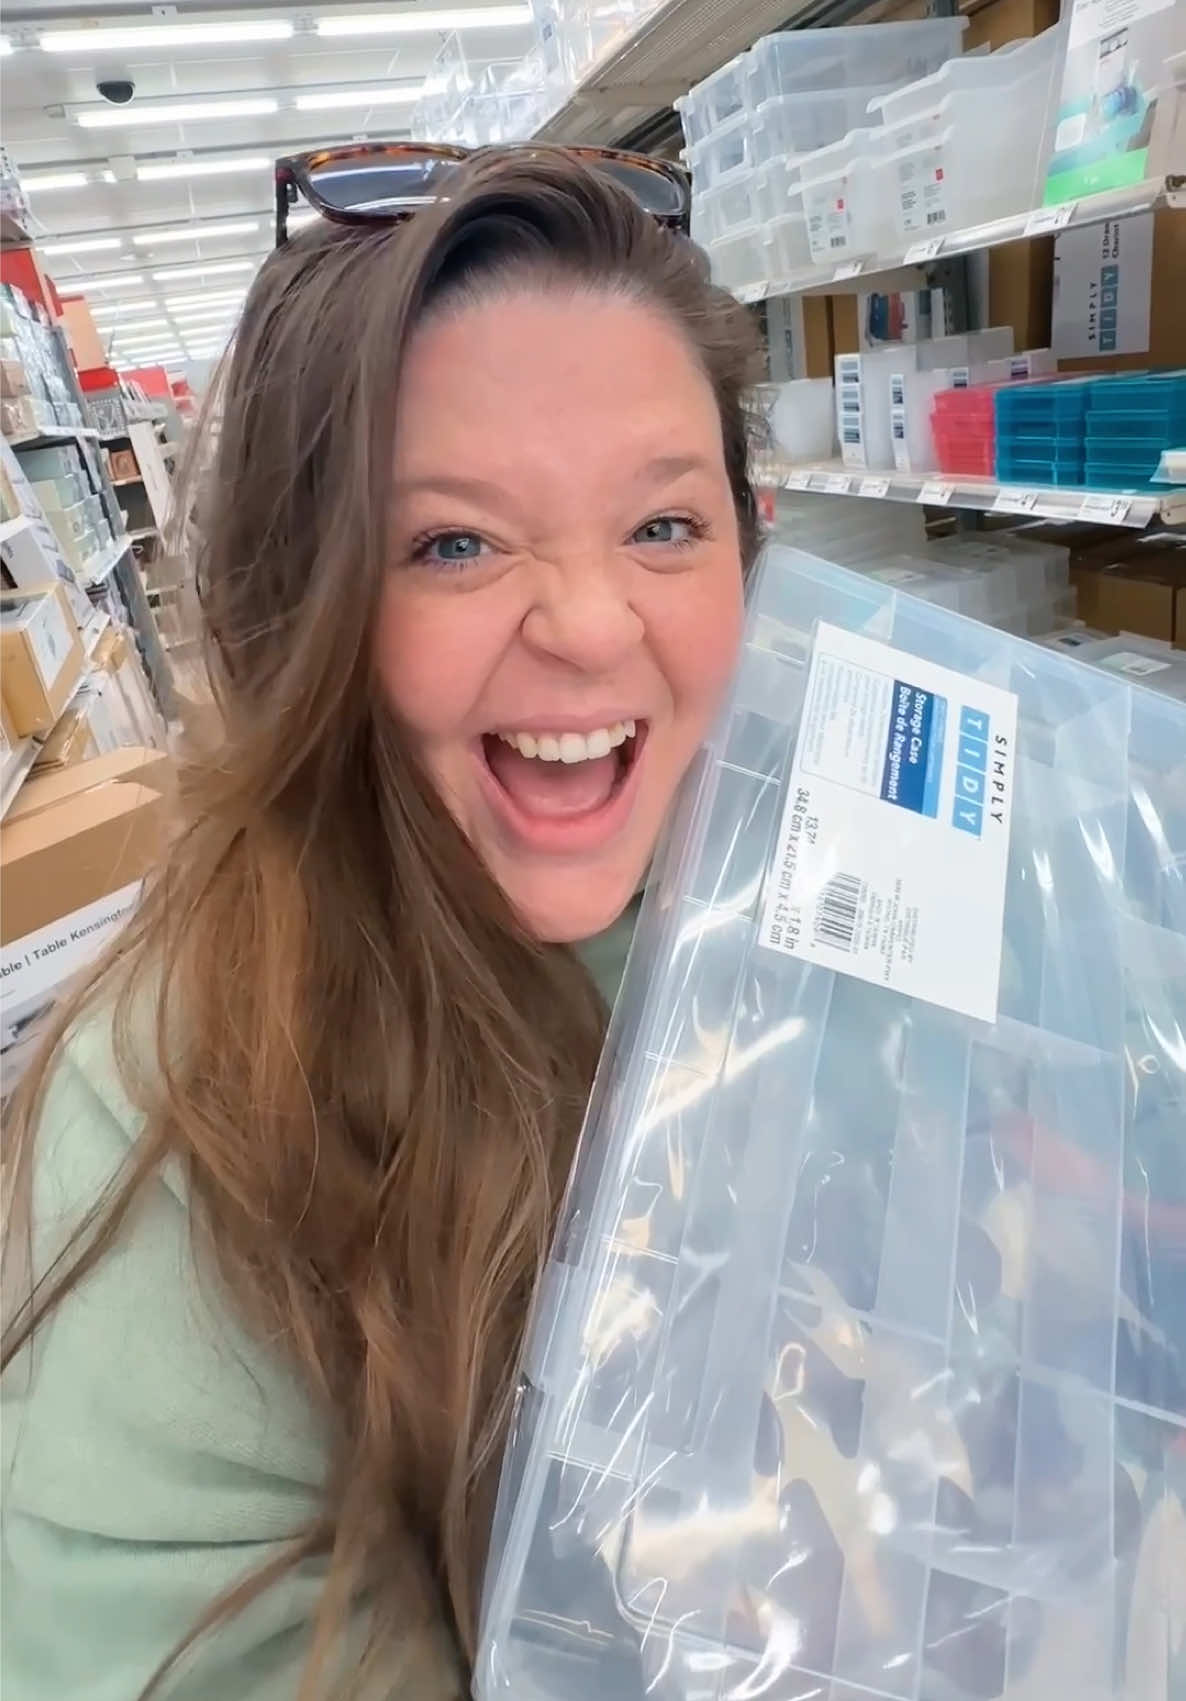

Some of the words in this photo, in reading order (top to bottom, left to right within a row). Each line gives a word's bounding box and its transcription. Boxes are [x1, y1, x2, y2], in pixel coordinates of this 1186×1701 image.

[1088, 282, 1097, 341] SIMPLY
[1101, 270, 1116, 347] TIDY
[895, 717, 908, 732] de
[910, 692, 927, 735] Storage
[908, 737, 922, 764] Case
[888, 732, 906, 800] Rangement
[959, 716, 984, 827] TIDY
[991, 735, 1008, 824] SIMPLY
[793, 788, 810, 814] 34.8
[790, 814, 803, 833] cm
[778, 871, 793, 891] cm
[774, 904, 789, 923] 4.5
[769, 924, 783, 945] cm
[784, 938, 799, 950] in
[32, 938, 68, 960] Table
